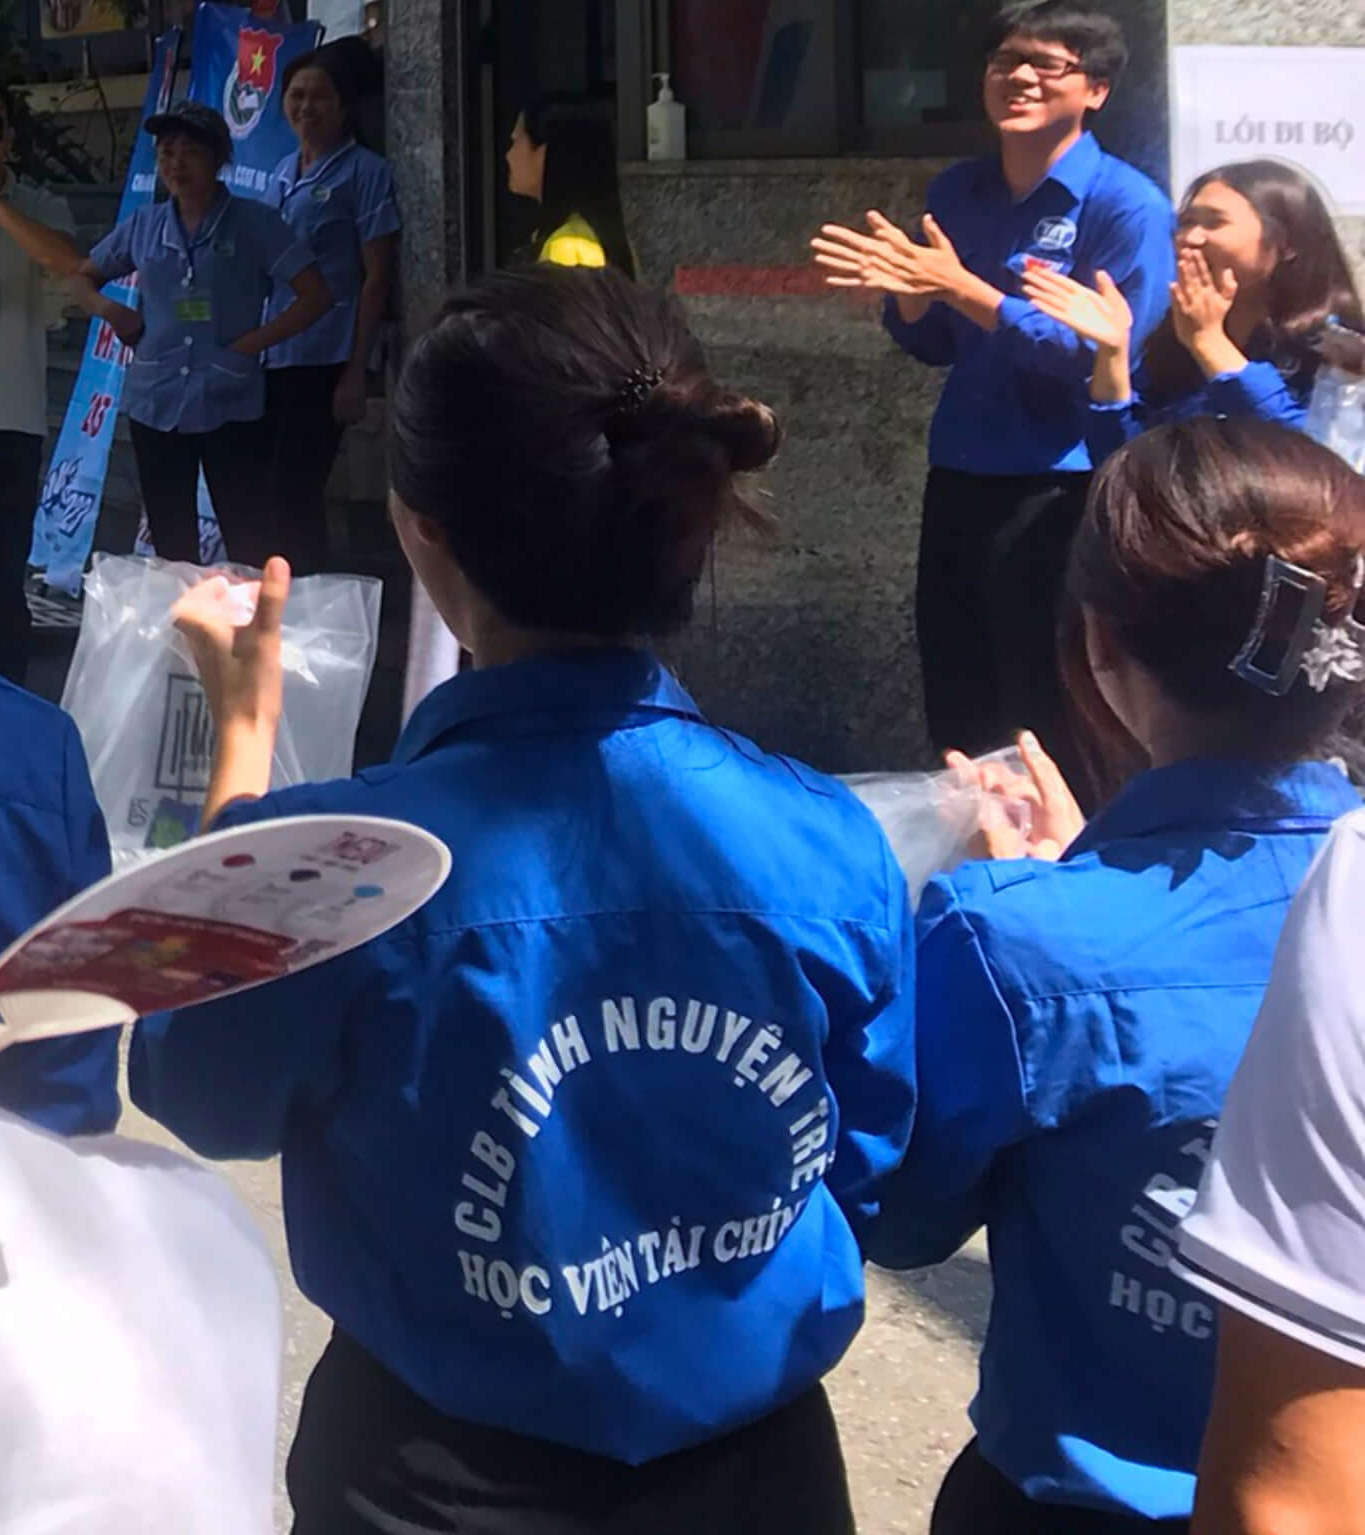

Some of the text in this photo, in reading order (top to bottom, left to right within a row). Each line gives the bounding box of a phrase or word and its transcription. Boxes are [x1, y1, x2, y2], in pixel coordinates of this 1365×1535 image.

[454, 1130, 516, 1243] CLB
[490, 1014, 591, 1139] TÌNH
[601, 996, 814, 1107] NGUYỆN
[457, 1249, 552, 1319] HỌC
[562, 1234, 640, 1318] VIỆN
[637, 1216, 706, 1284] TÀI
[1109, 1269, 1214, 1339] HỌC
